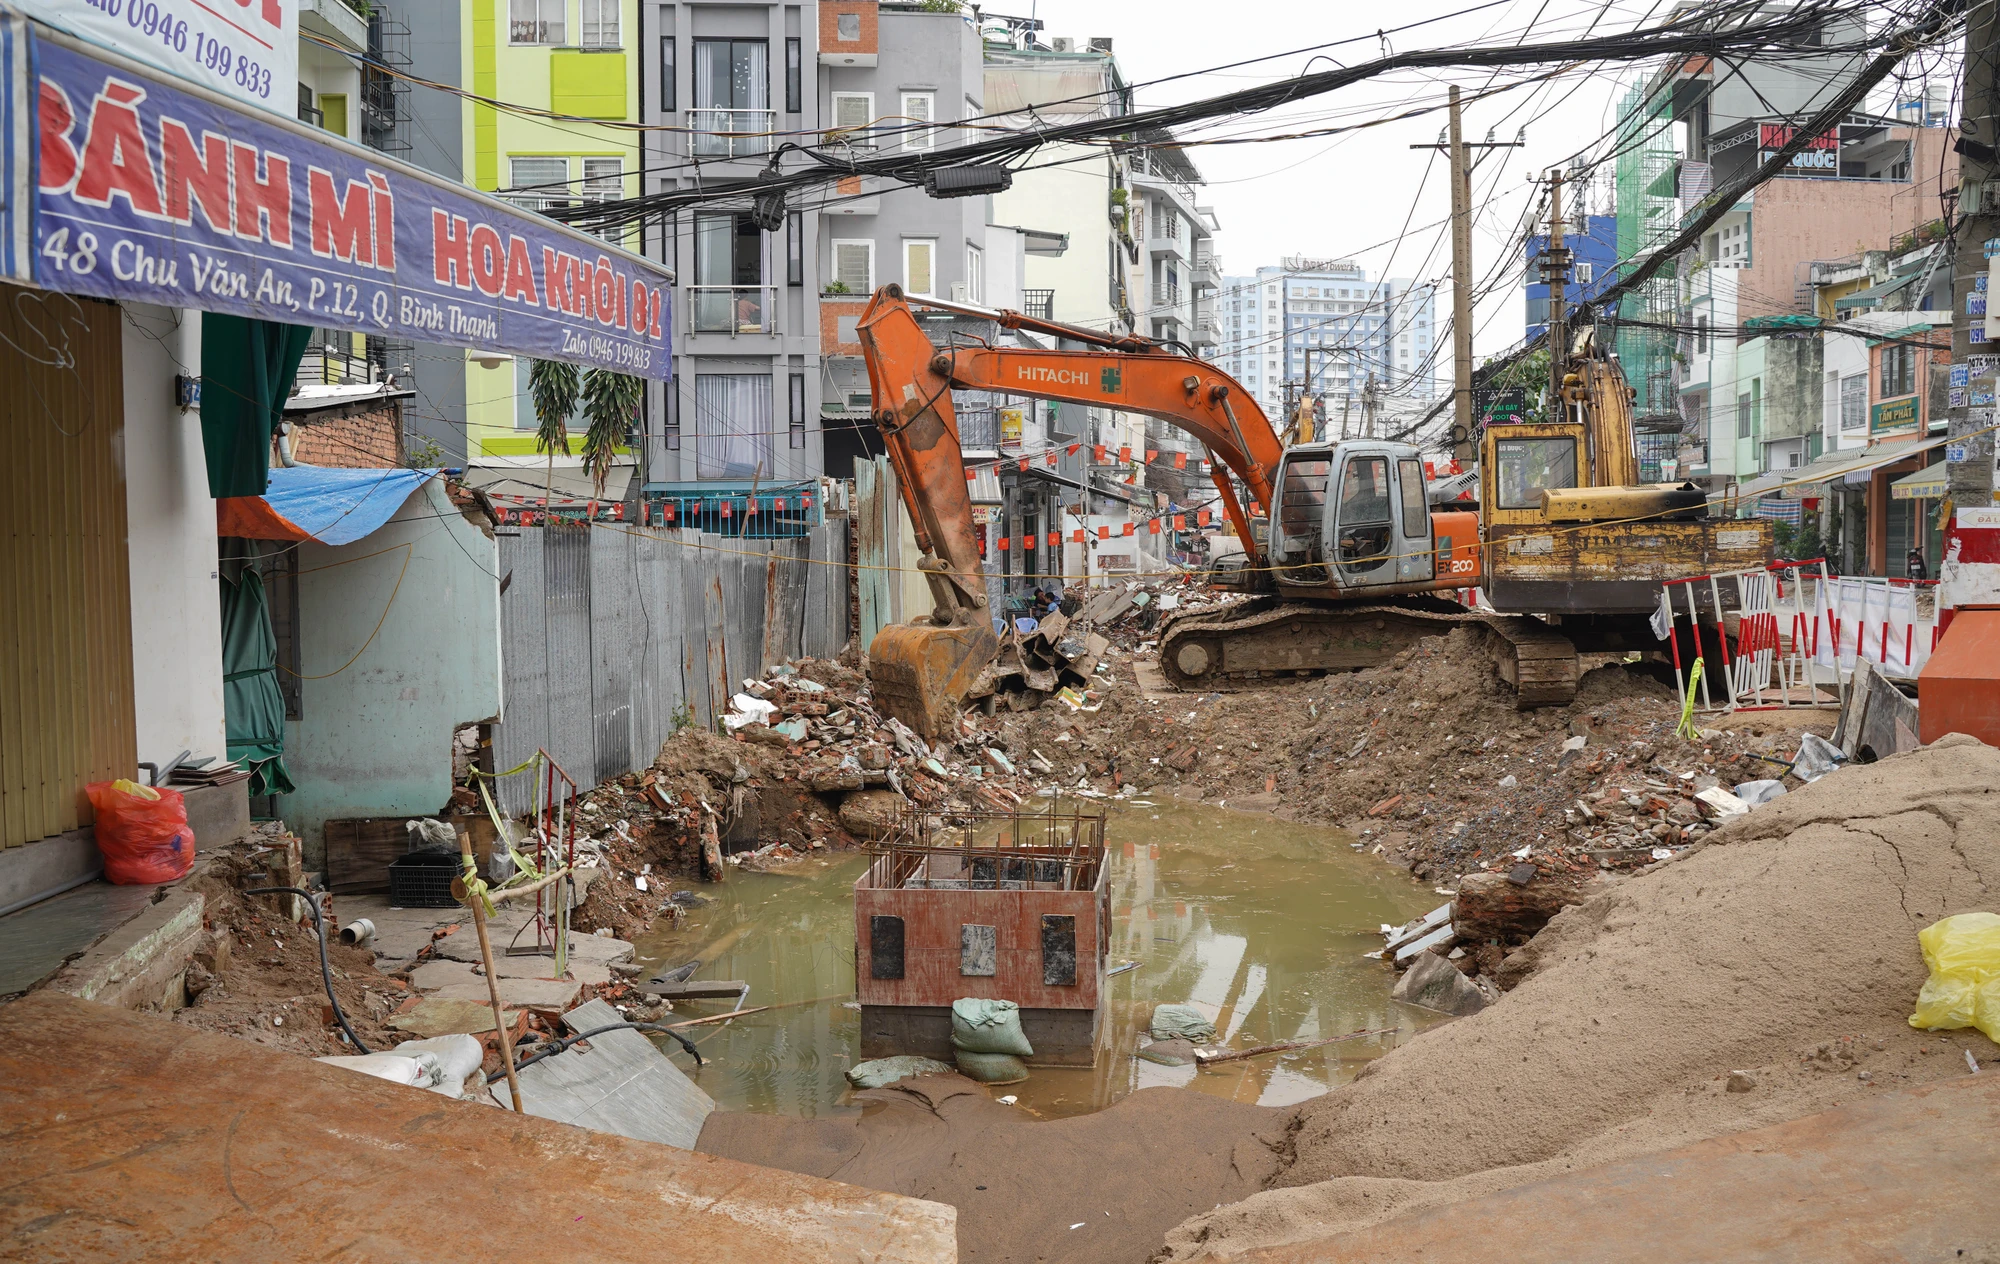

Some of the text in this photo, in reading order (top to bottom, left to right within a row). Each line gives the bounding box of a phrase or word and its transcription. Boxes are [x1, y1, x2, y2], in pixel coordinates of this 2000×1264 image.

[127, 0, 188, 52] 0946
[195, 32, 232, 77] 199
[235, 55, 272, 99] 833
[1792, 149, 1834, 168] QUỐC
[308, 164, 396, 273] MÌ
[432, 206, 540, 307] HOA
[543, 244, 627, 330] KHÔI
[38, 226, 498, 341] 48 Chu Văn An, P.12, Q. Bình Thạnh
[562, 328, 651, 370] Zalo 0946 199 833
[1018, 365, 1089, 386] HITACHI
